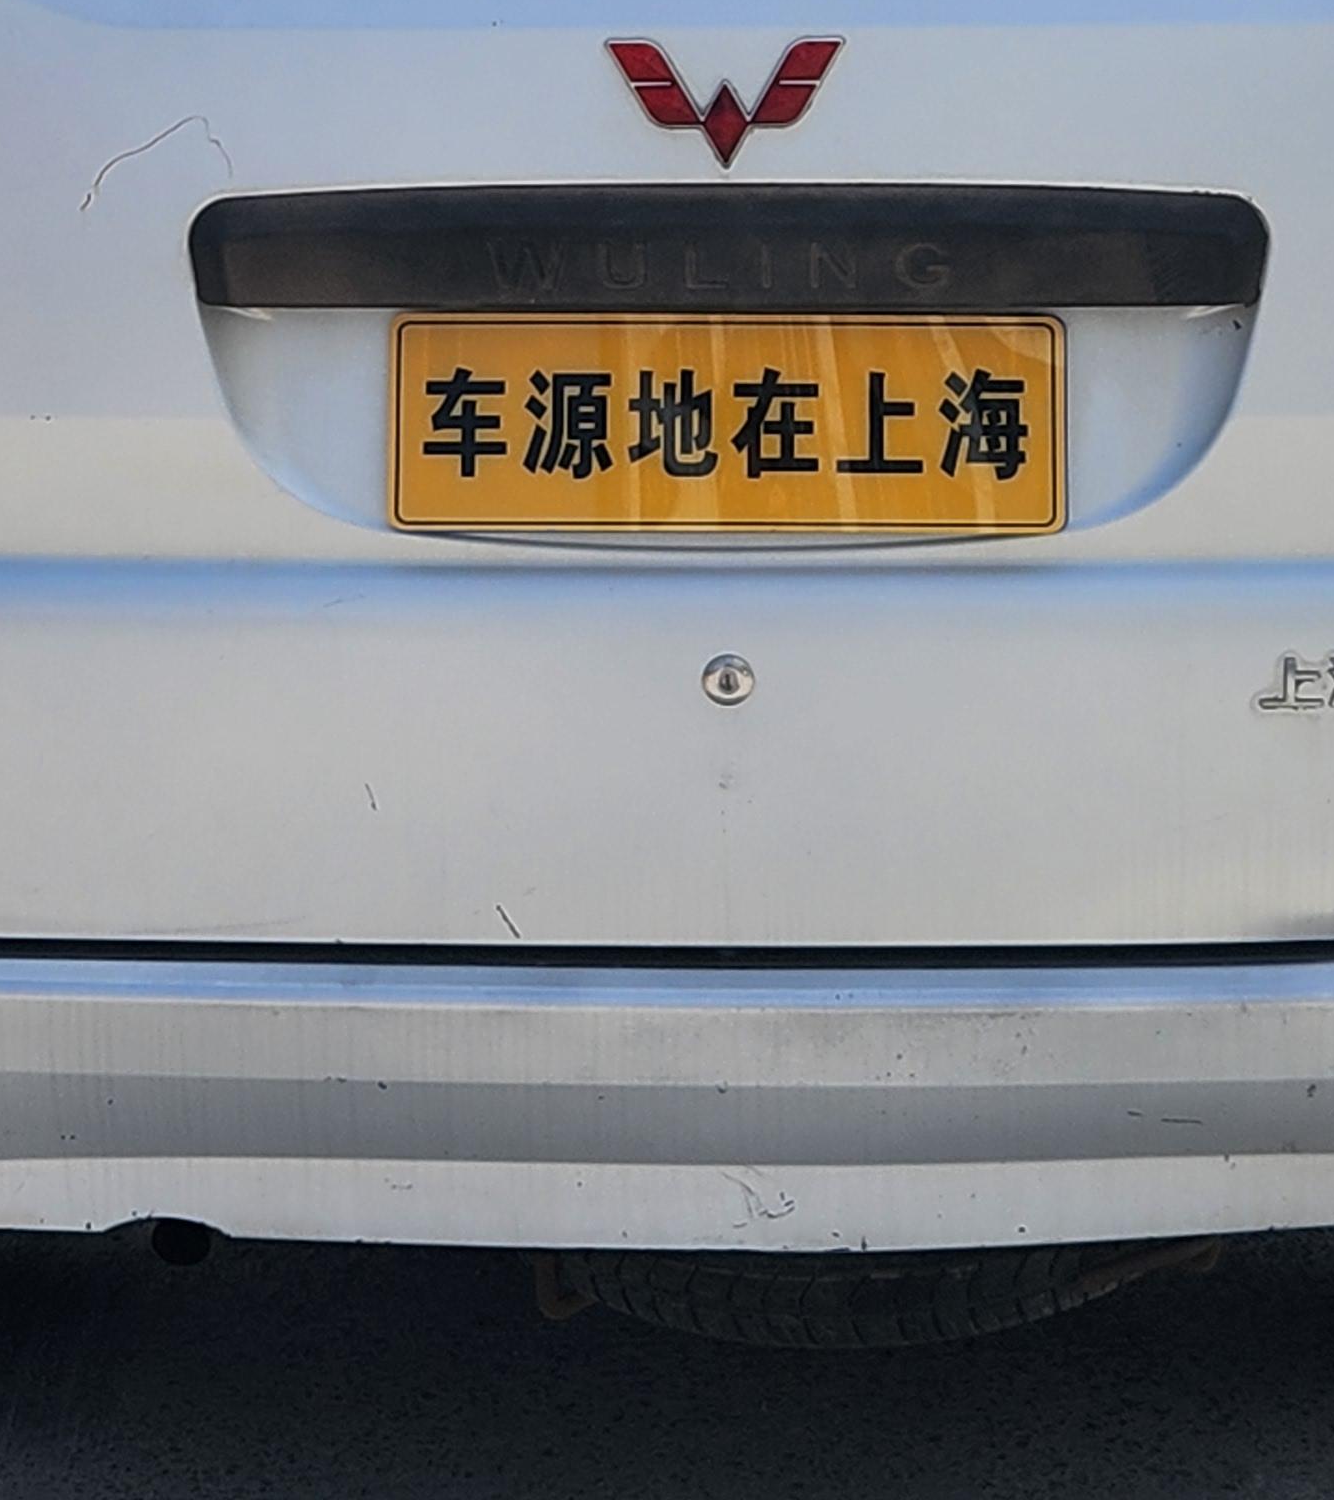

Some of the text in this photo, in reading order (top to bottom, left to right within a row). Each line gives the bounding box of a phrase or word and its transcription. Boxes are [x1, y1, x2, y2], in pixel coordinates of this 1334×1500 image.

[484, 237, 953, 291] WULING
[421, 366, 1030, 481] 车源地在上海
